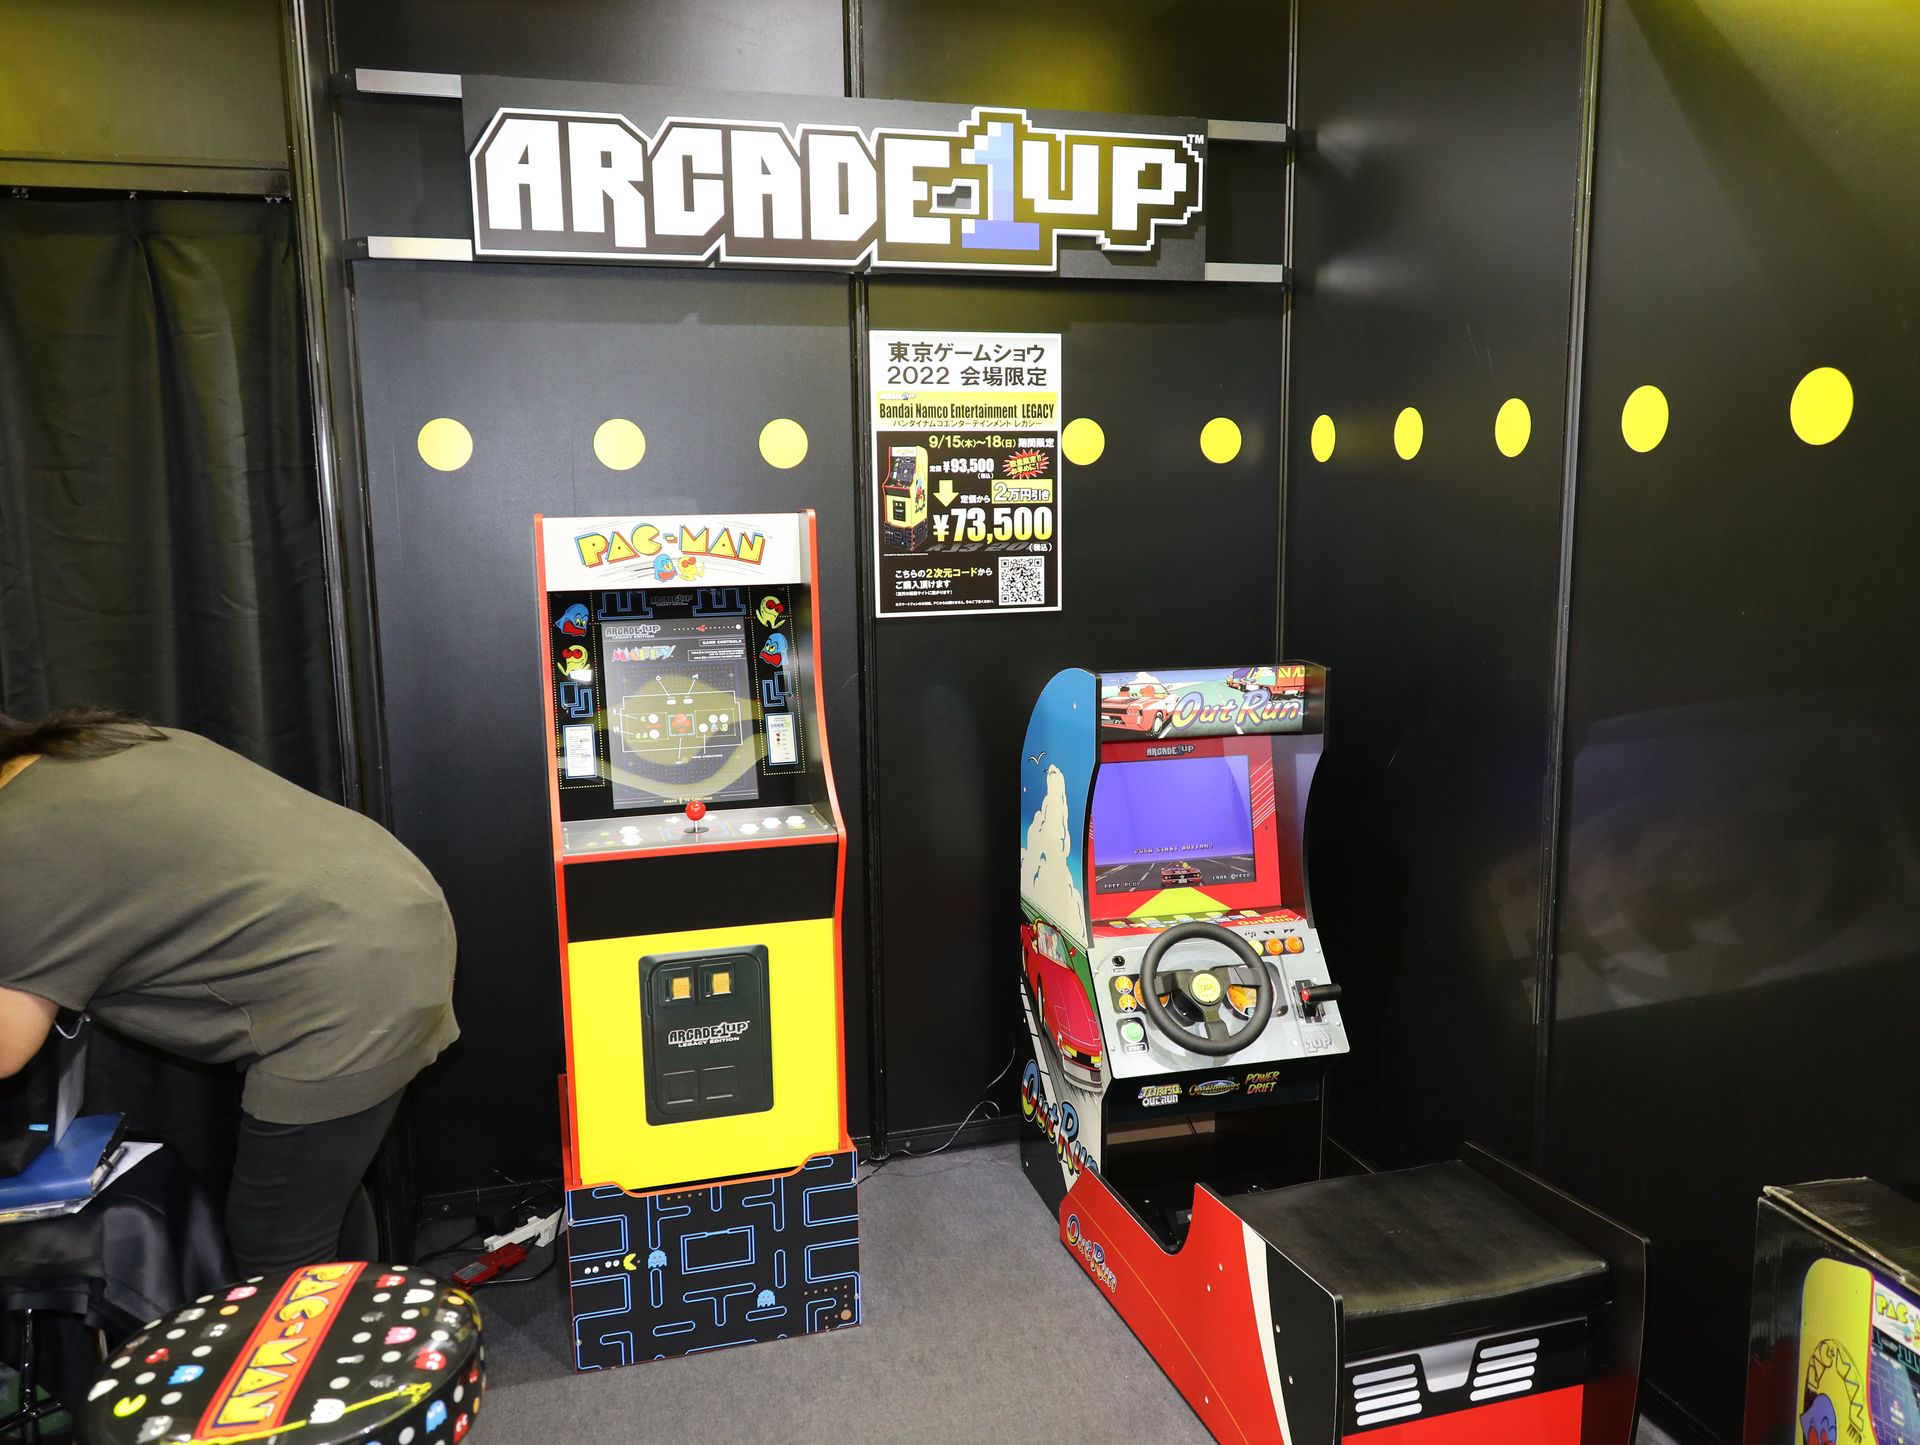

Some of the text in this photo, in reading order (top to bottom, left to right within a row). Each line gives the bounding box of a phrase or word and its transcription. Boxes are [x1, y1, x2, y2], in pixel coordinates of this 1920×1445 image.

[887, 341, 1045, 363] 東京ゲームショウ
[887, 366, 1048, 387] 2022 会場限定
[879, 403, 1055, 419] Bandai Namco Entertainment LEGACY
[1018, 437, 1055, 448] 期間限定
[942, 457, 995, 474] ¥93,500
[960, 482, 1050, 504] 定価から 2万円引き
[932, 506, 1053, 545] ¥73,500
[574, 523, 766, 568] PAC-MAN
[895, 567, 993, 579] こちらの2次元コードから
[611, 644, 676, 662] MAPPY
[678, 1040, 708, 1048] LEGACY
[1245, 1070, 1280, 1084] POWER
[1139, 1083, 1183, 1098] TURBO
[1247, 1082, 1277, 1095] DRIFT
[212, 1264, 354, 1428] PAC-MAN
